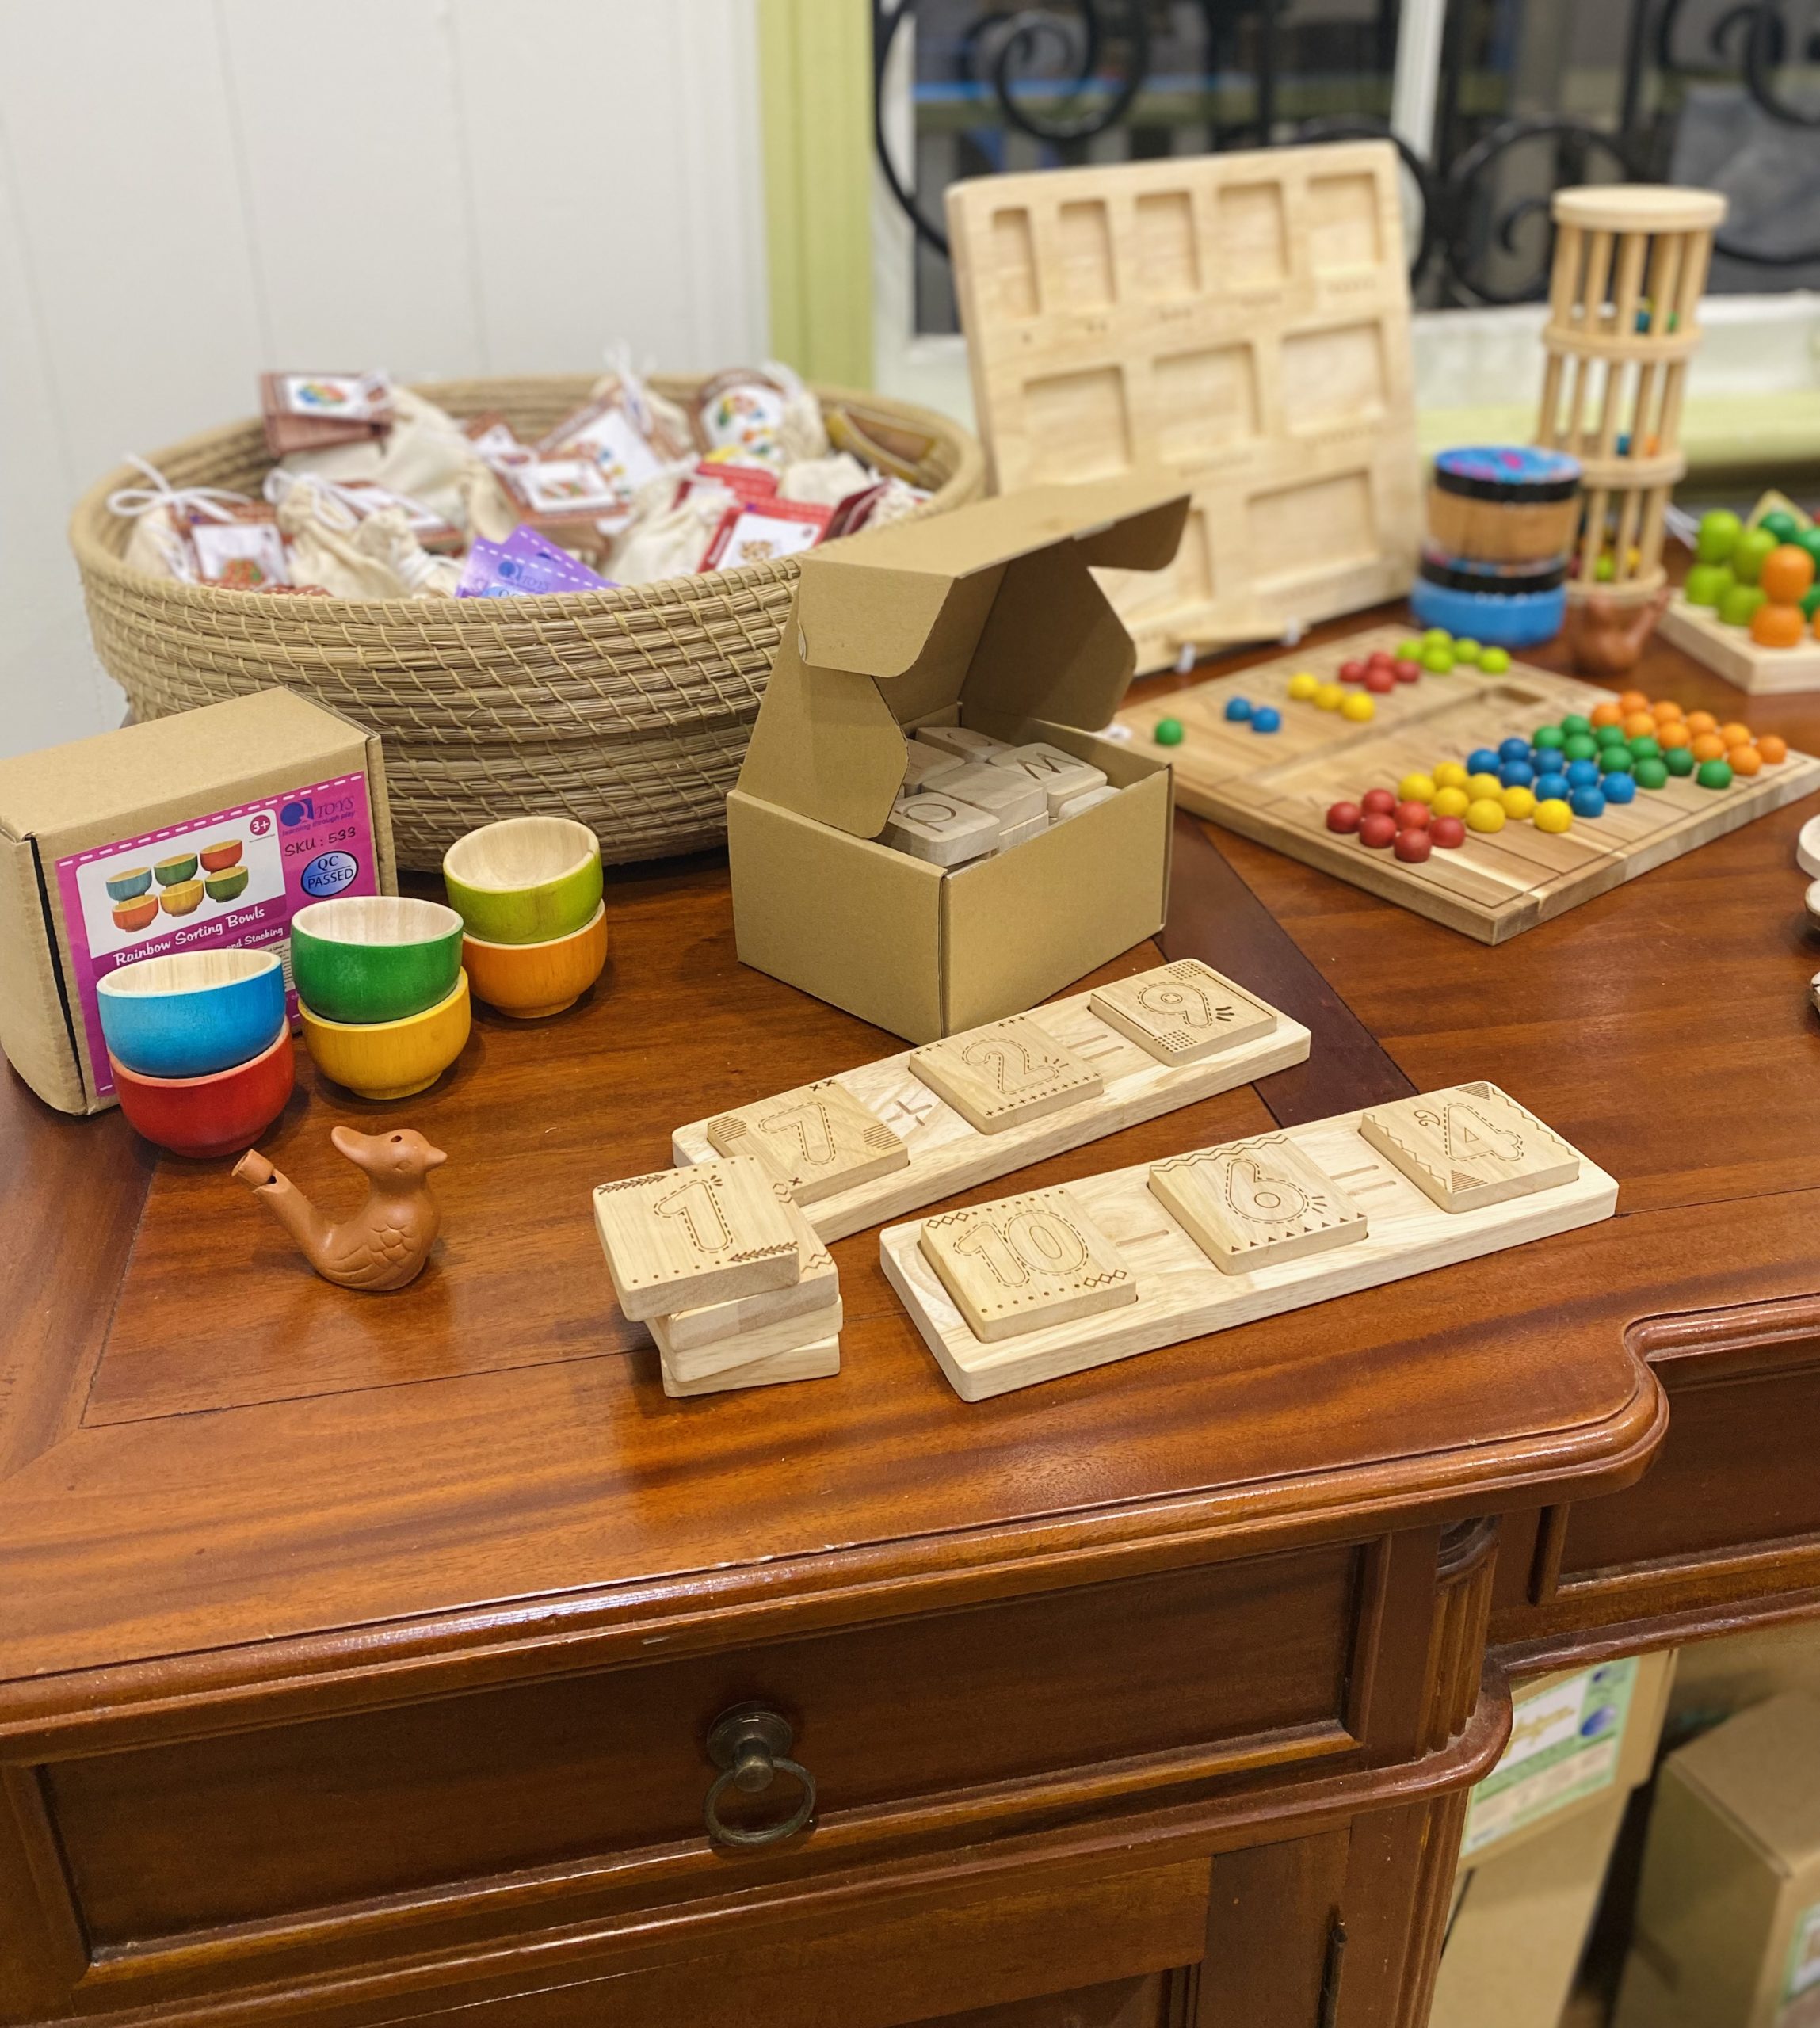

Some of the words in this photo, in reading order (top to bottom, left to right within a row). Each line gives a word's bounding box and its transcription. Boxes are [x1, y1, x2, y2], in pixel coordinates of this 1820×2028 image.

[316, 795, 354, 818] TOYS
[253, 820, 269, 833] 3+
[282, 824, 311, 837] learning
[313, 815, 341, 828] through
[341, 811, 356, 820] play
[284, 837, 316, 857] SKU
[328, 826, 356, 844] 533
[317, 855, 339, 871] QC
[307, 868, 354, 890] PASSED
[113, 940, 172, 966] Rainbow
[175, 923, 223, 946] Sorting
[226, 905, 265, 928] Bowls
[244, 926, 284, 944] Stacking
[758, 1100, 837, 1165] 7
[961, 1037, 1060, 1095] 2
[1136, 981, 1213, 1029] 9
[953, 1209, 1089, 1288] 10
[1224, 1158, 1311, 1225] 6
[1444, 1103, 1524, 1162] 4
[654, 1179, 734, 1253] 1
